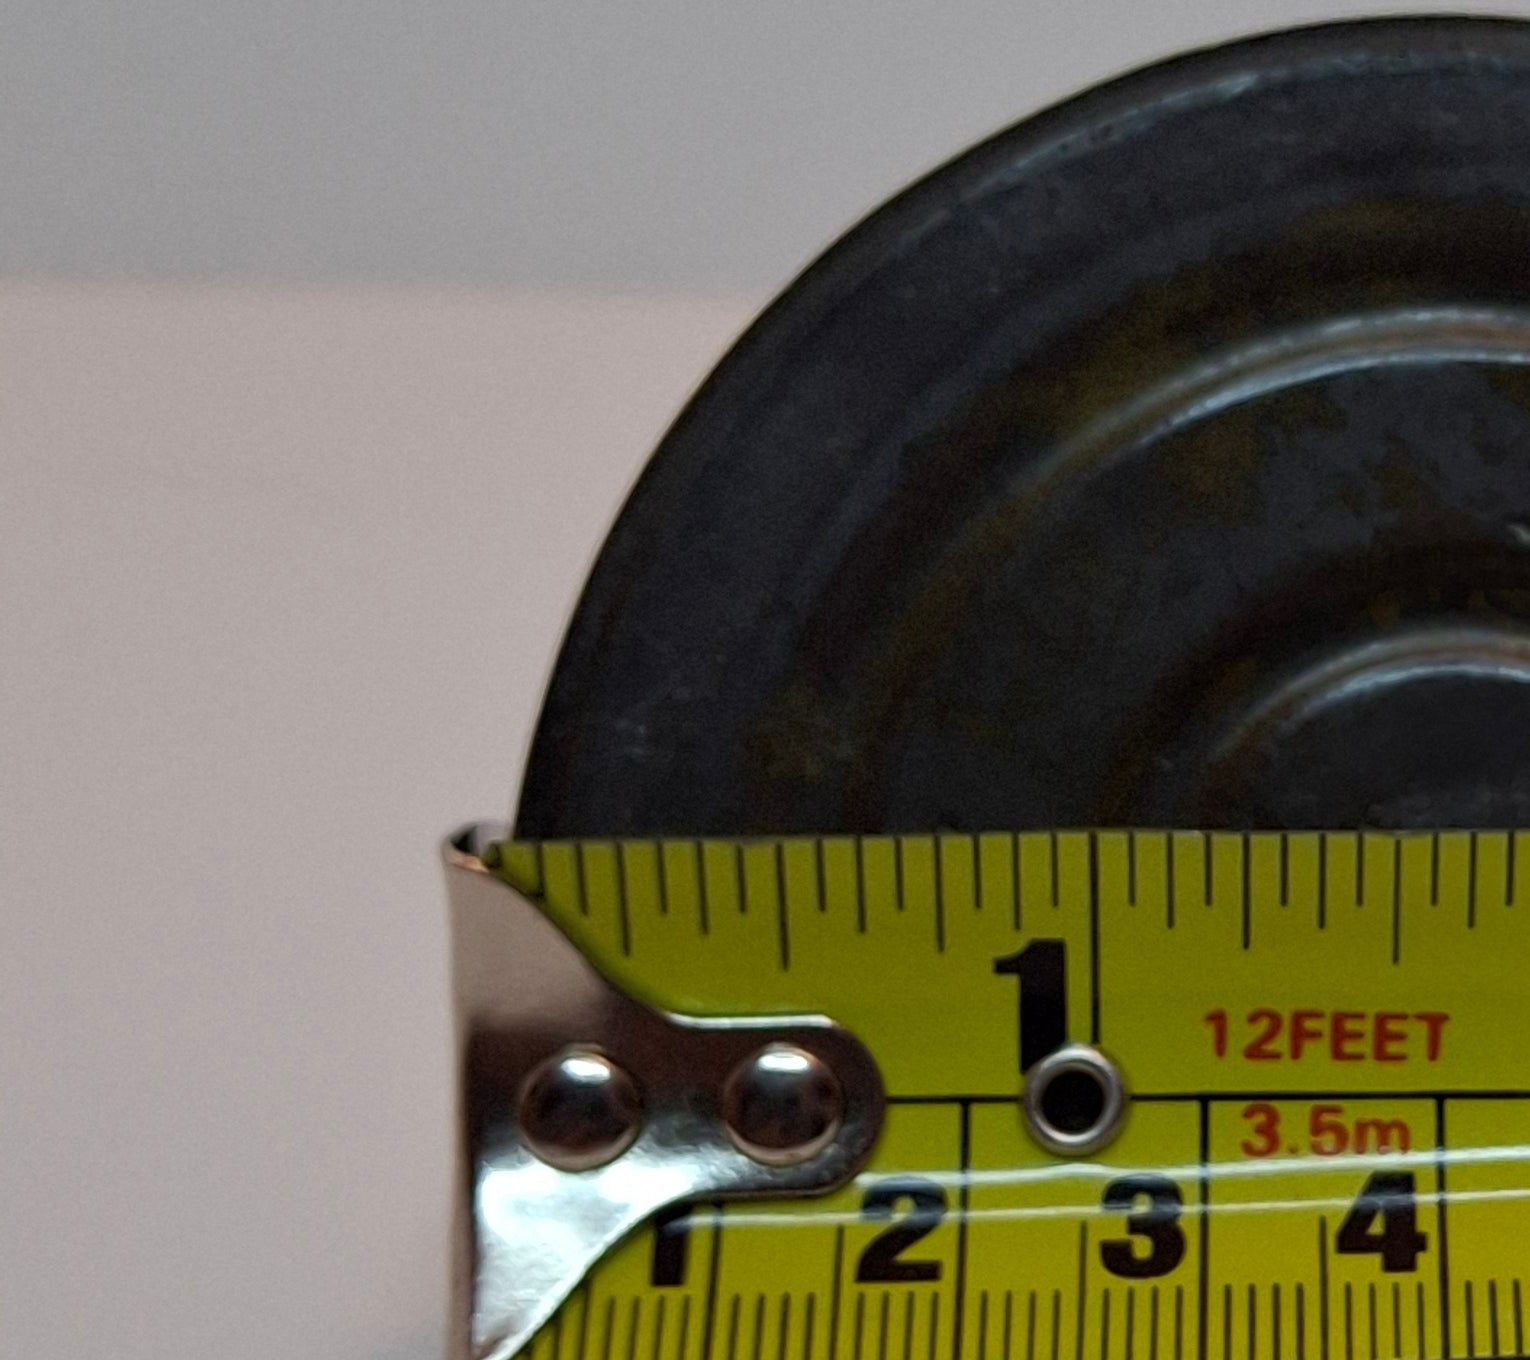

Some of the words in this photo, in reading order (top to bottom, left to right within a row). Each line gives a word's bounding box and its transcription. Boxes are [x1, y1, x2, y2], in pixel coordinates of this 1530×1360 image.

[993, 939, 1066, 1073] 1
[1203, 1010, 1451, 1063] 12FEET
[1241, 1103, 1412, 1158] 3.5m
[856, 1177, 948, 1283] 2
[1100, 1175, 1186, 1279] 3
[1335, 1169, 1428, 1273] 4
